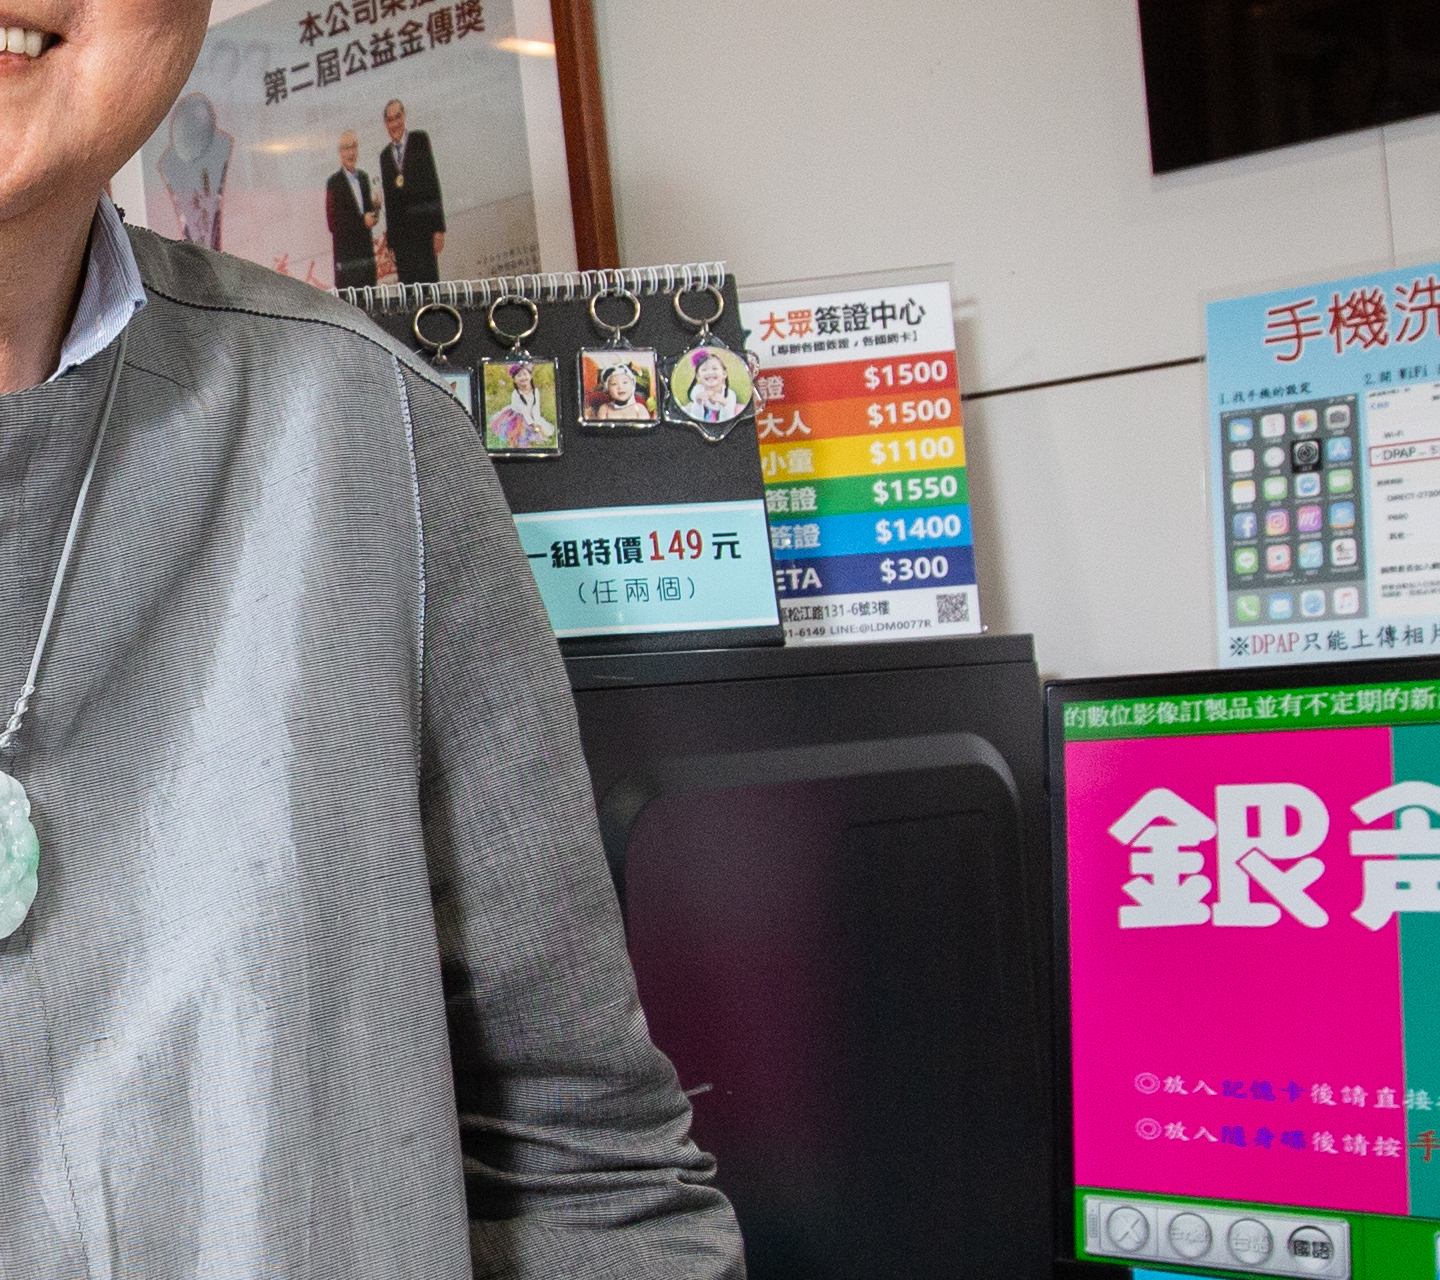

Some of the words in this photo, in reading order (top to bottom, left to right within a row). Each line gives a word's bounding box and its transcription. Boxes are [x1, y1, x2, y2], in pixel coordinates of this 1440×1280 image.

[759, 297, 926, 342] 大眾簽證中心
[864, 360, 948, 389] $1500
[758, 410, 811, 439] 大人
[867, 398, 951, 428] $1500
[761, 448, 814, 476] 小童
[869, 435, 955, 466] $1100
[766, 486, 817, 513] 簽證
[873, 475, 958, 505] $1550
[875, 514, 961, 545] $1400
[880, 555, 949, 584] $300
